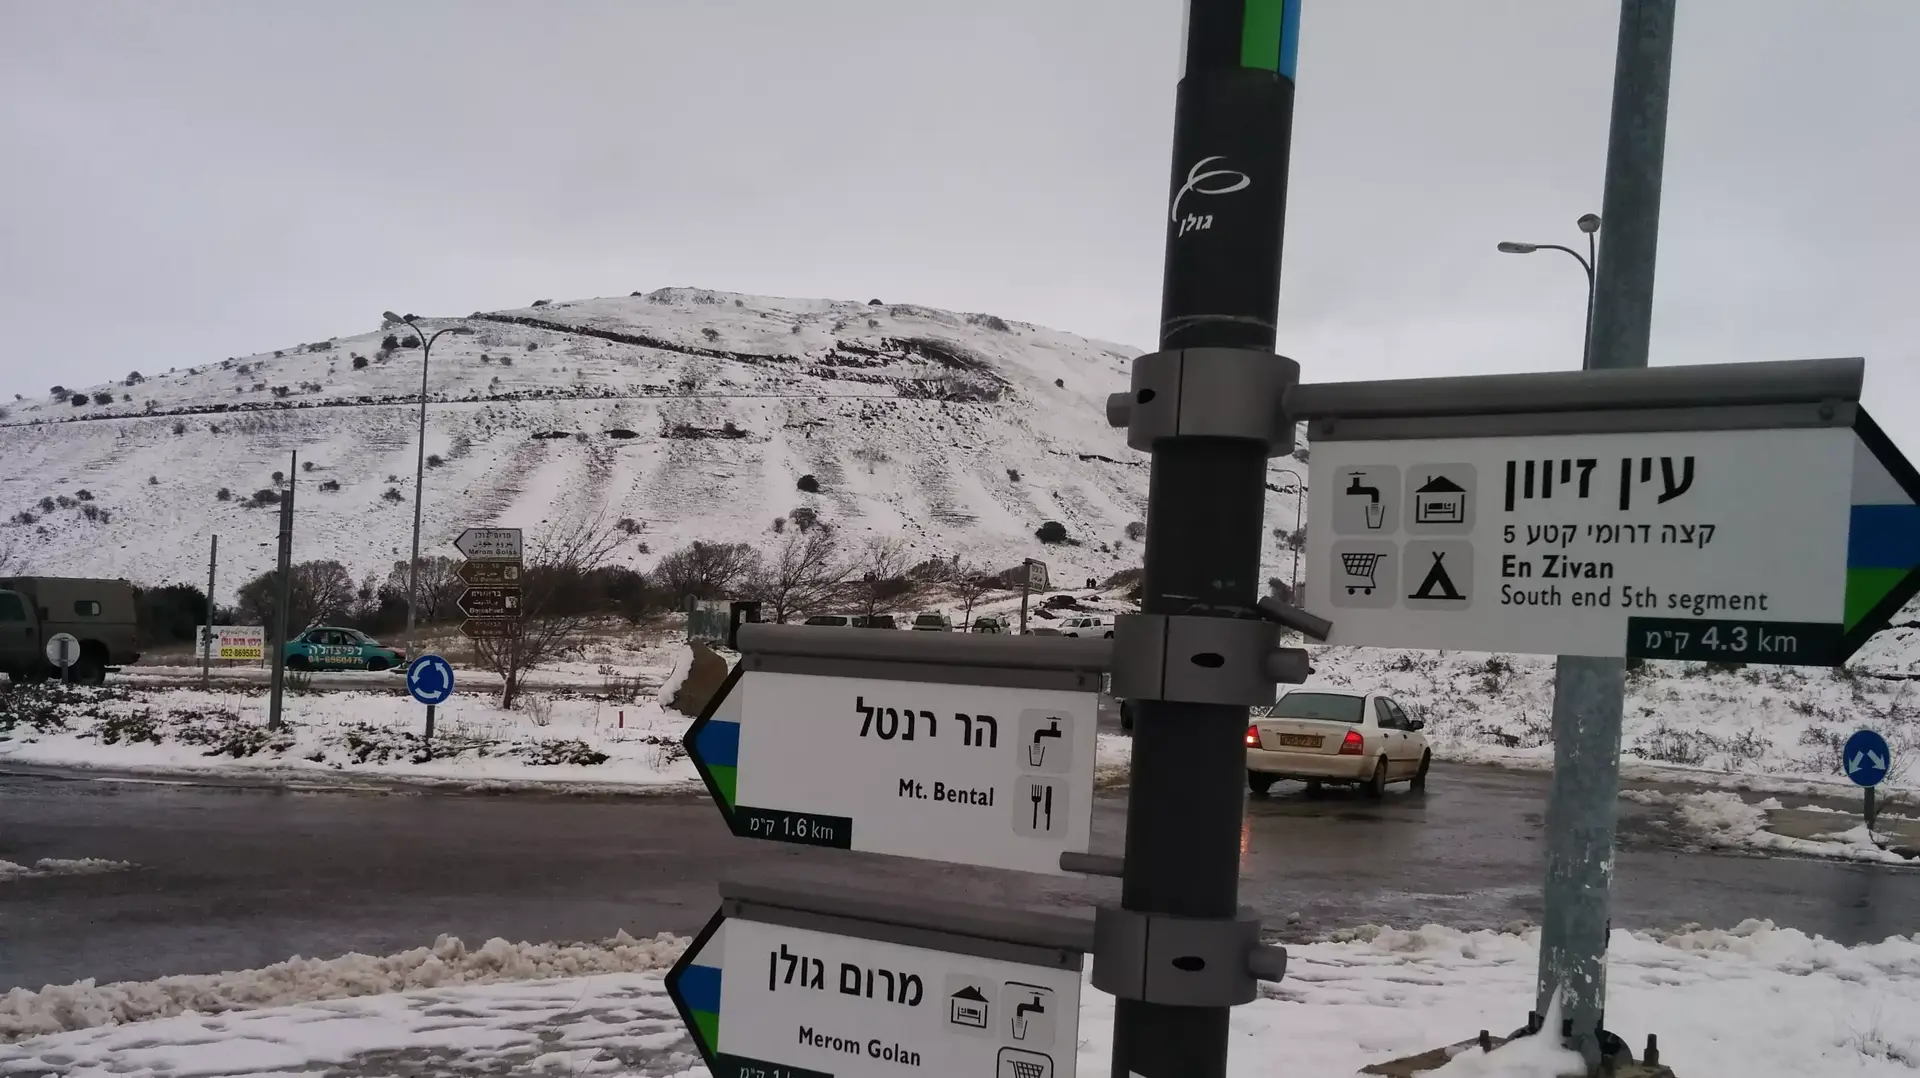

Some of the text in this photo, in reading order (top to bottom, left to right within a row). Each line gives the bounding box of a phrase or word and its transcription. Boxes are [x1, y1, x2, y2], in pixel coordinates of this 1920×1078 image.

[1178, 213, 1213, 238] גולן
[1504, 456, 1695, 512] עין זיוון
[1503, 524, 1716, 547] קצה דרומי קטע 5
[1501, 554, 1614, 579] En Zivan
[1500, 584, 1768, 615] South end 5th segment
[1701, 626, 1748, 652] 4.3
[1757, 627, 1797, 654] km
[954, 713, 998, 749] הר
[898, 778, 994, 807] Mt. Bental
[783, 816, 807, 837] 1.6
[811, 820, 834, 840] km
[768, 943, 924, 1007] מרום גולן
[798, 1025, 921, 1067] Merom Golan
